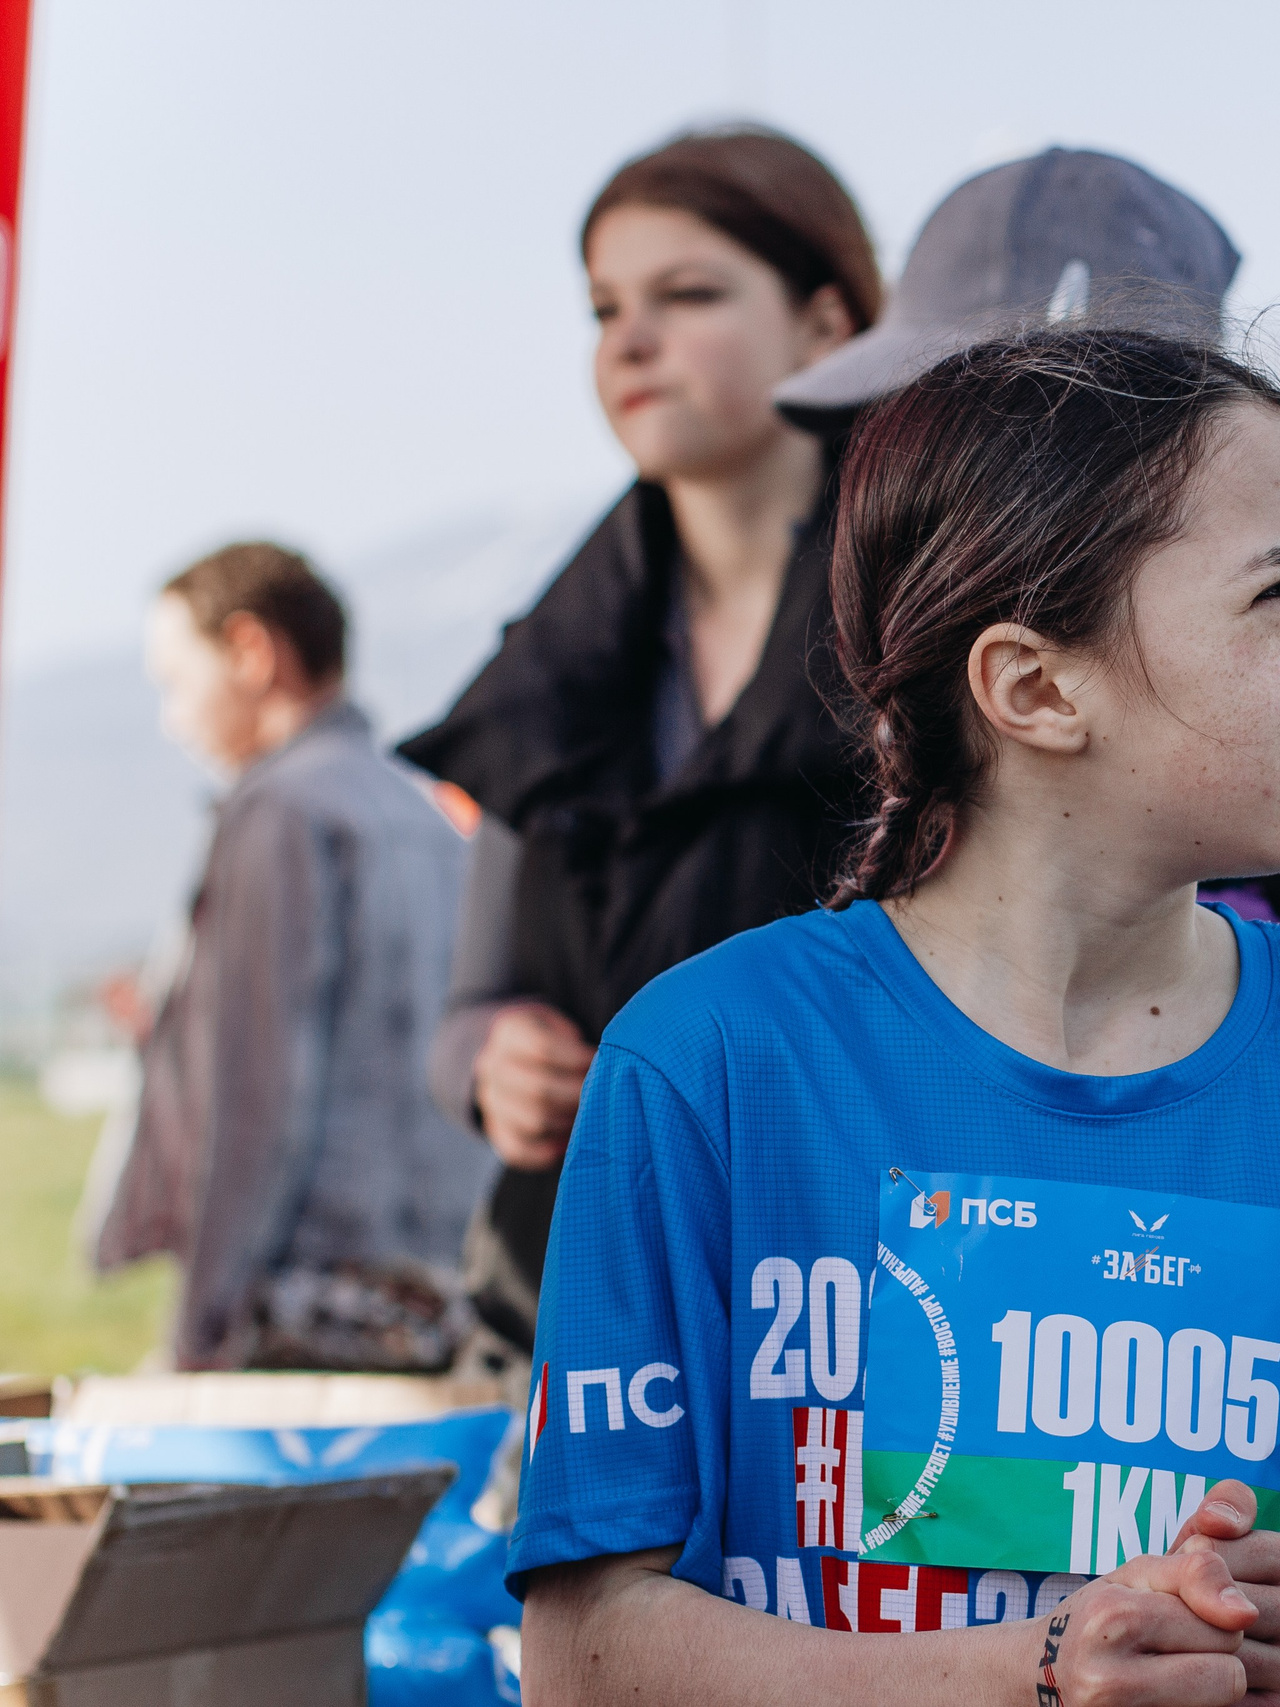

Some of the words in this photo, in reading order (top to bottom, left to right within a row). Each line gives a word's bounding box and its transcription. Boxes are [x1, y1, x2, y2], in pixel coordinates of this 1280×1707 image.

[961, 1197, 1038, 1229] ПСБ
[750, 1256, 877, 1402] 20
[918, 1294, 958, 1357] #ВОСТОРГ
[936, 1357, 961, 1442] #УДИВЛЕНИЕ
[914, 1440, 952, 1497] #ТРЕПЕТ
[864, 1489, 927, 1550] #ВОЛНЕНИЕ
